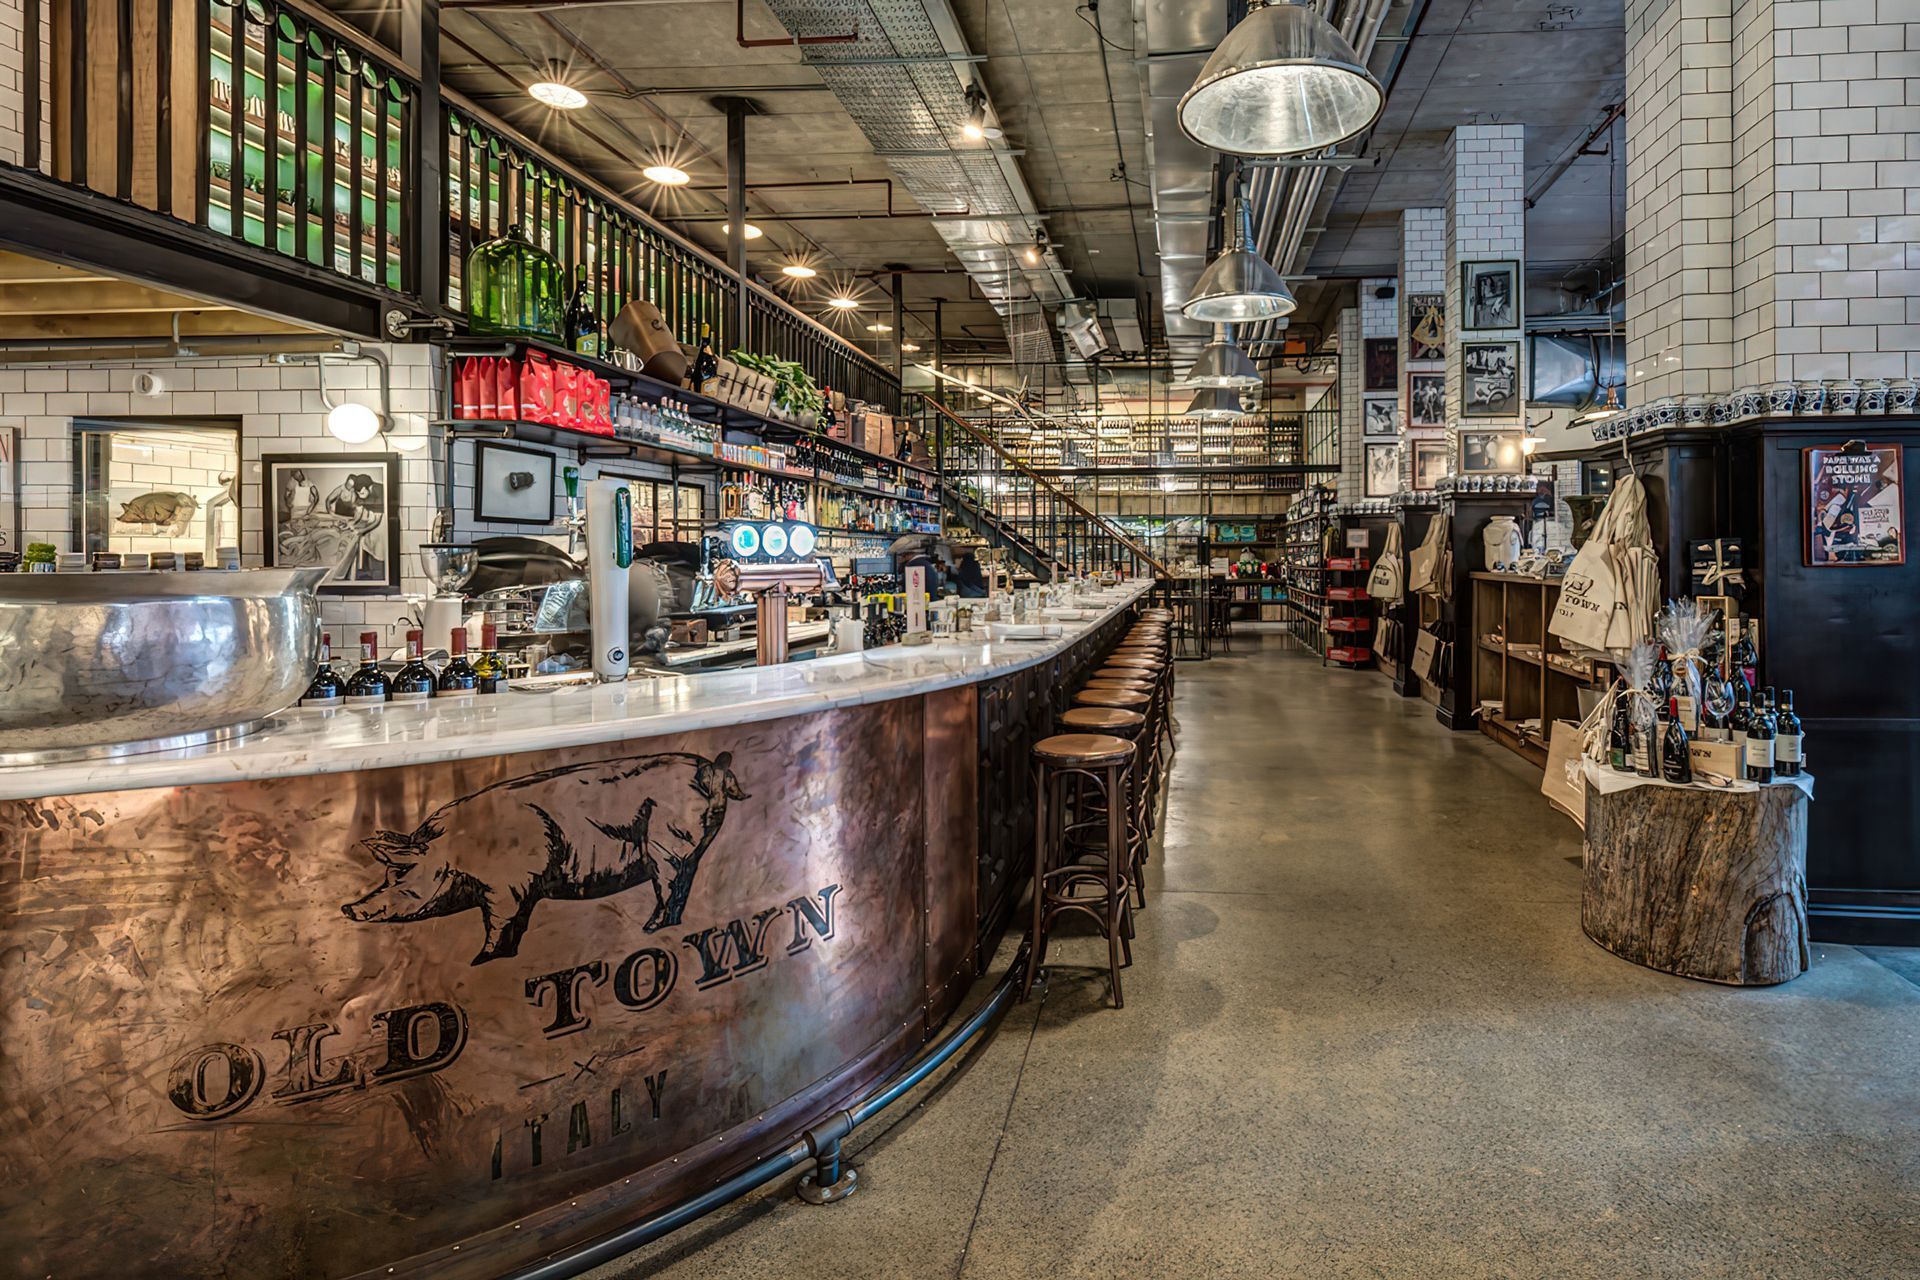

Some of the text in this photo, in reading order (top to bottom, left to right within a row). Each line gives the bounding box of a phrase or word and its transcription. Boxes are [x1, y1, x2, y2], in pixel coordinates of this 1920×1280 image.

[1849, 455, 1871, 463] WAS
[1874, 455, 1881, 463] A
[1825, 464, 1878, 474] ROLLING
[1831, 475, 1871, 484] STONE
[1565, 595, 1600, 612] TOWN
[167, 884, 843, 1121] OLD TOWN
[491, 1069, 668, 1181] ITALY
